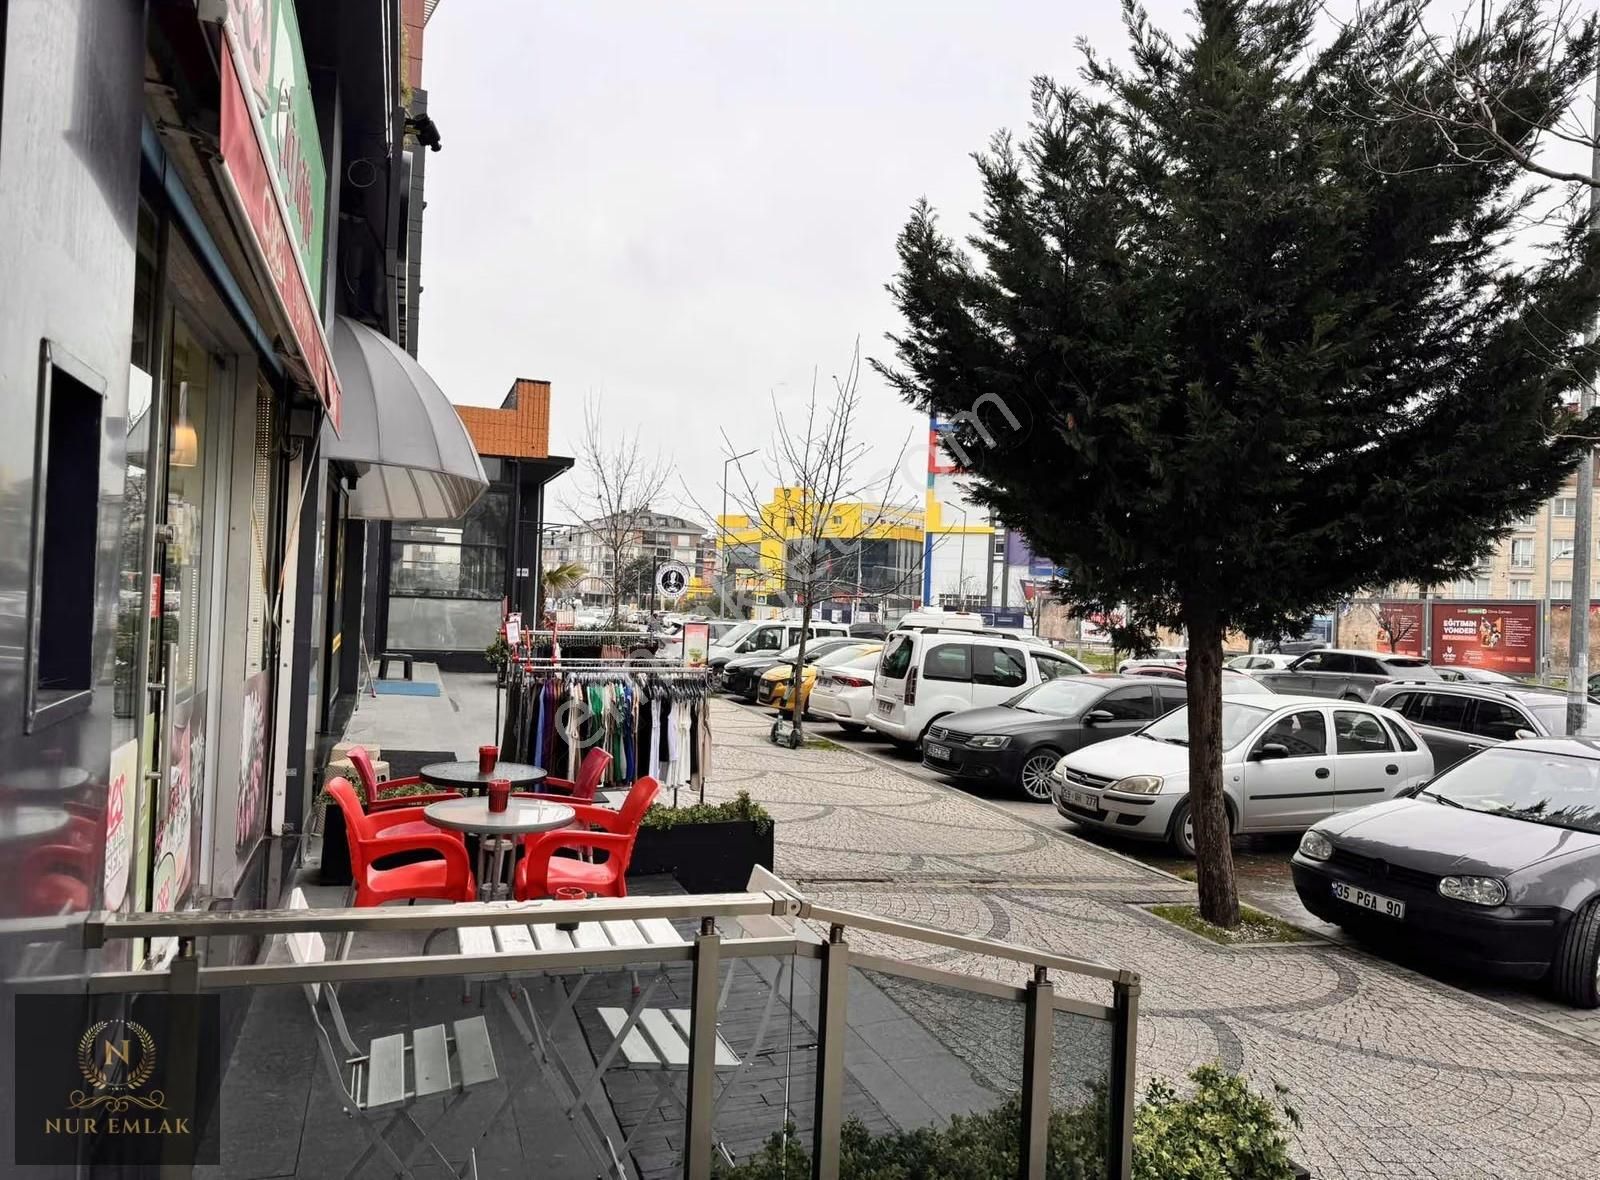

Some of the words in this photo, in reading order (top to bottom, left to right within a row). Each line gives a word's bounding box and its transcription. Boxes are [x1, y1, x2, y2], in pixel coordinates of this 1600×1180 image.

[1337, 884, 1350, 899] 35
[1357, 891, 1377, 910] PGA
[1387, 901, 1401, 917] 90
